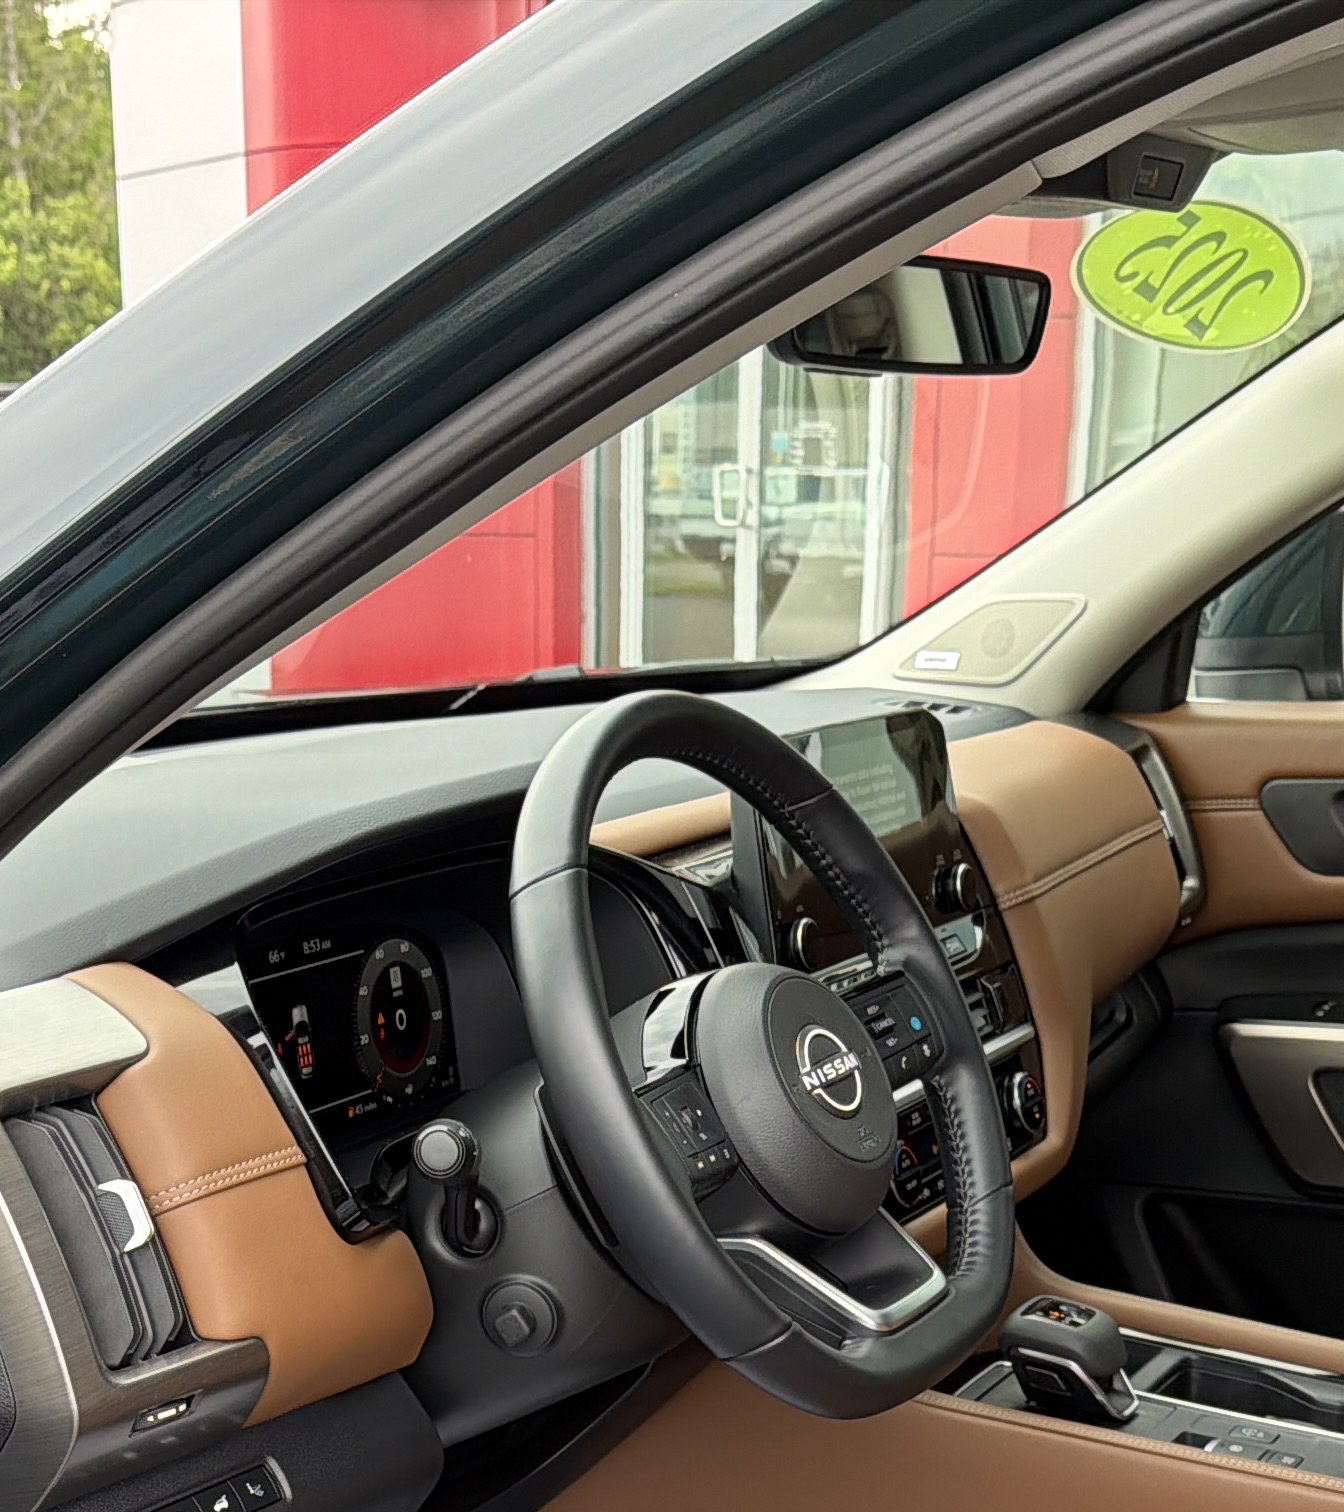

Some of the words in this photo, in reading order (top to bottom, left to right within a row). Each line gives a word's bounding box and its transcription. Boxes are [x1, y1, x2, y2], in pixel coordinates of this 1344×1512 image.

[302, 937, 321, 955] 8:53
[420, 964, 434, 979] 100
[395, 1008, 407, 1031] 0
[802, 1052, 859, 1091] NISSAN
